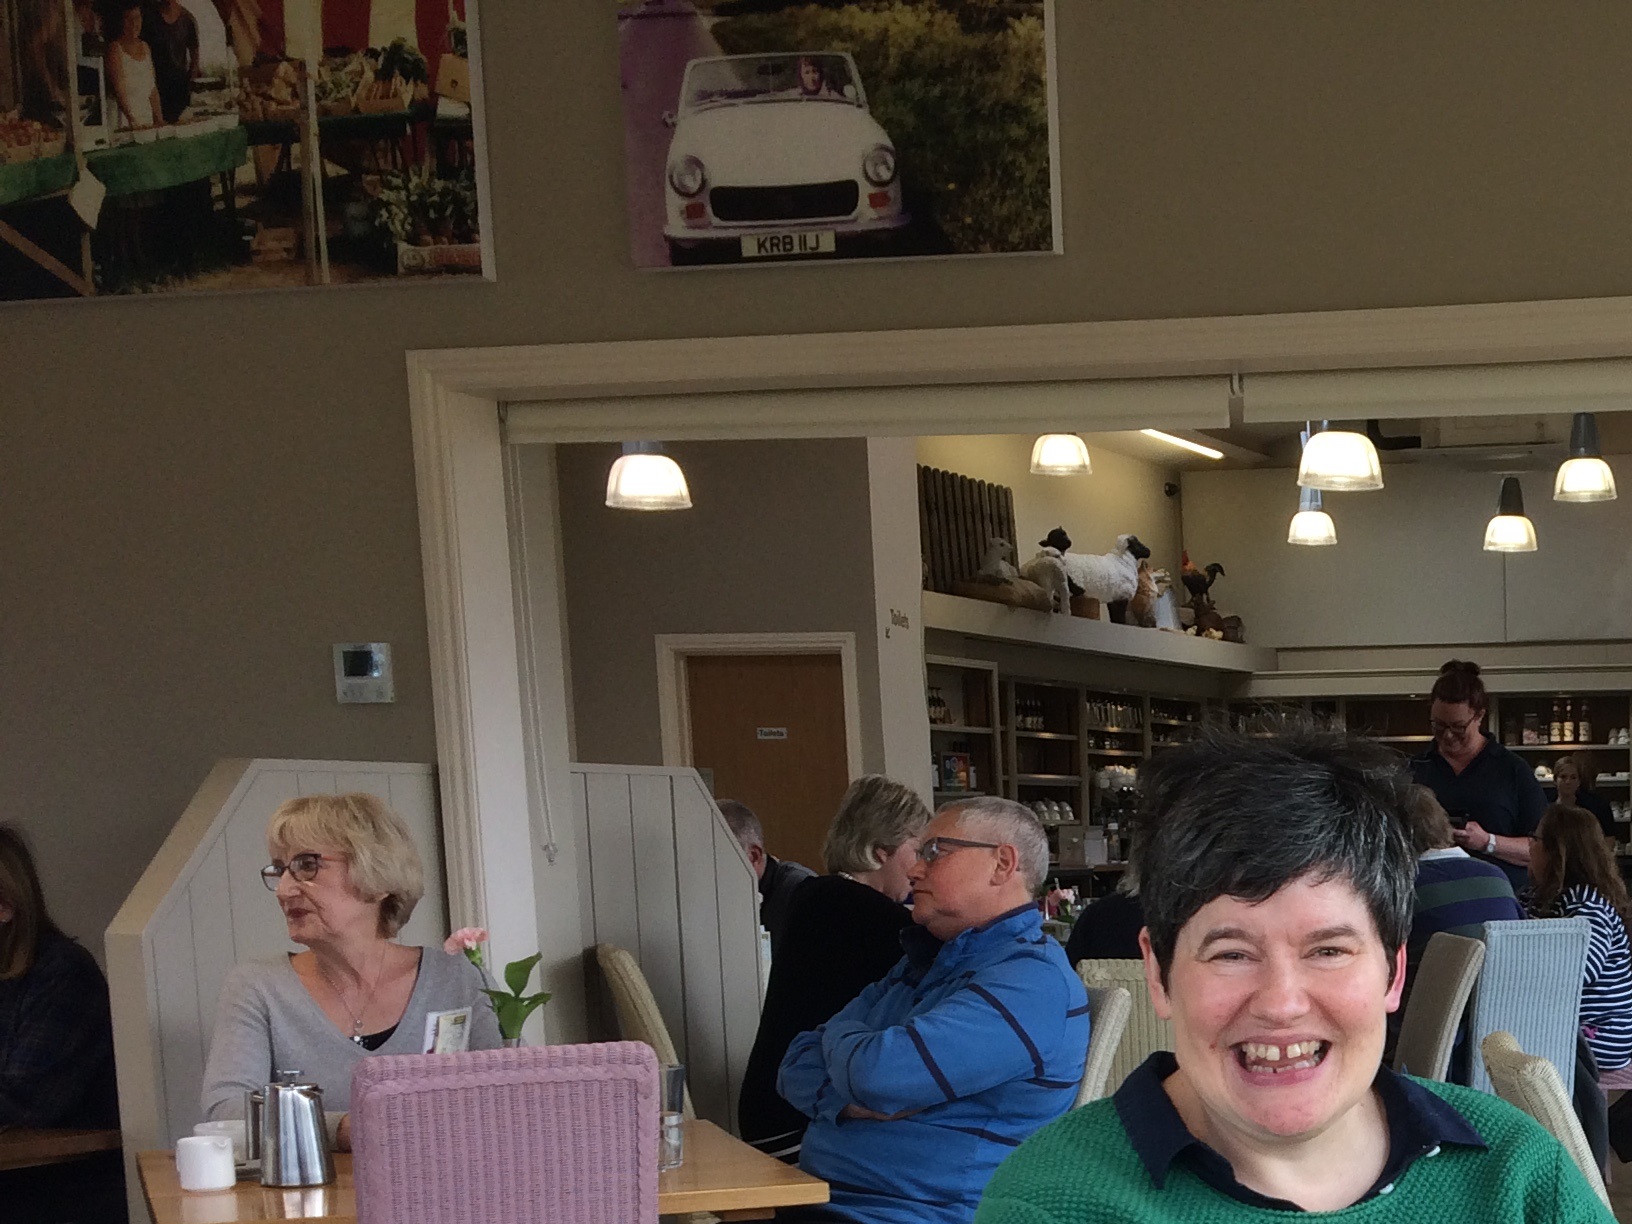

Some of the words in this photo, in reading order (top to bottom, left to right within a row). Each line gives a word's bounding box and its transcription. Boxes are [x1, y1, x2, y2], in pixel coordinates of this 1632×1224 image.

[757, 235, 794, 254] KRB
[890, 609, 909, 629] Toilets
[759, 729, 785, 737] Toilets
